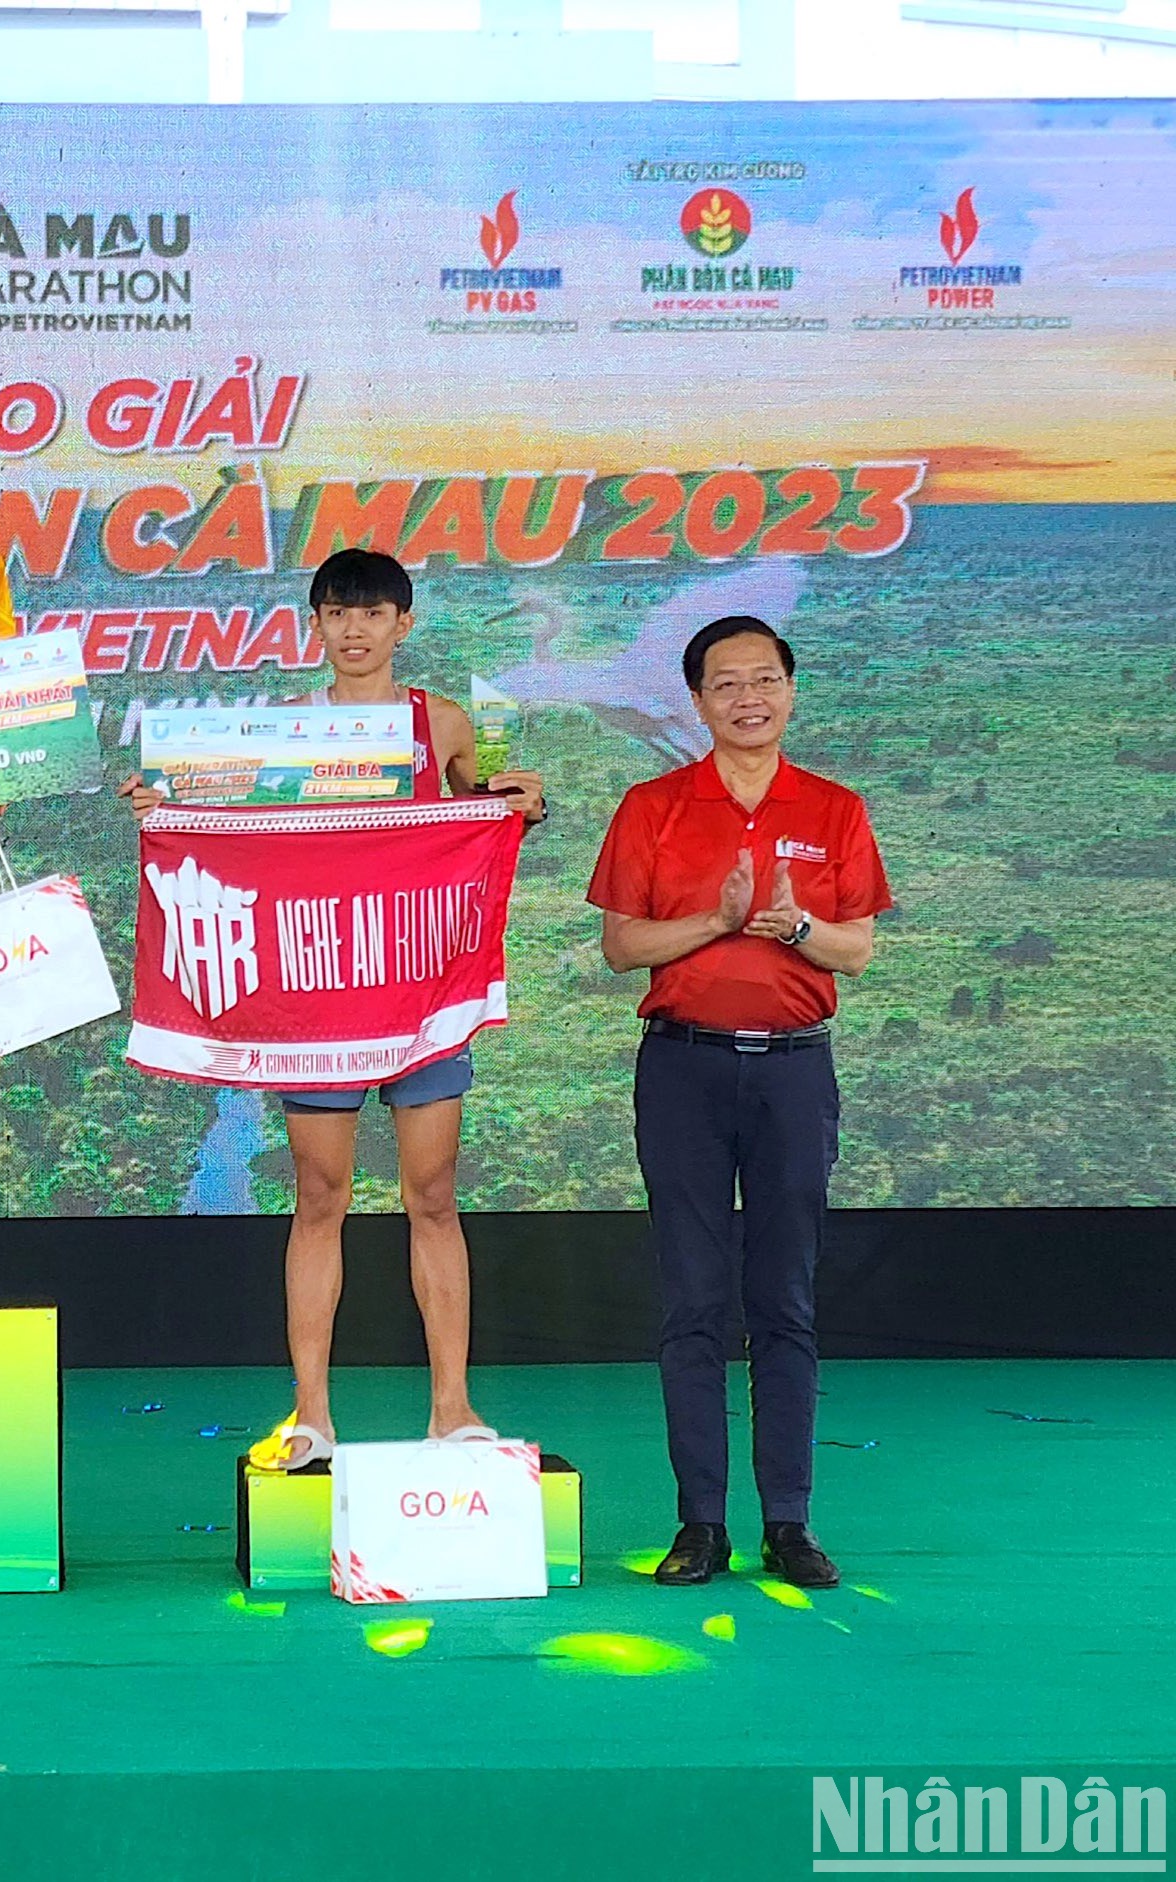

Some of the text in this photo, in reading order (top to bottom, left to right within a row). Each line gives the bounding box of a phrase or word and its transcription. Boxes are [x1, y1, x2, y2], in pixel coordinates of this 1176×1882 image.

[45, 213, 191, 259] MAU
[899, 266, 1022, 286] PETROVIETNAM
[467, 291, 537, 313] PV GAS
[928, 288, 995, 309] POWER
[86, 356, 308, 455] GIẢI
[103, 460, 275, 577] CÀ
[299, 468, 596, 574] MAU
[601, 460, 928, 564] 2023
[25, 679, 73, 706] NHẤT
[313, 759, 382, 778] GIẢI BA
[276, 898, 345, 992] NGHE
[352, 893, 386, 988] AN
[266, 1053, 333, 1075] CONNECTION
